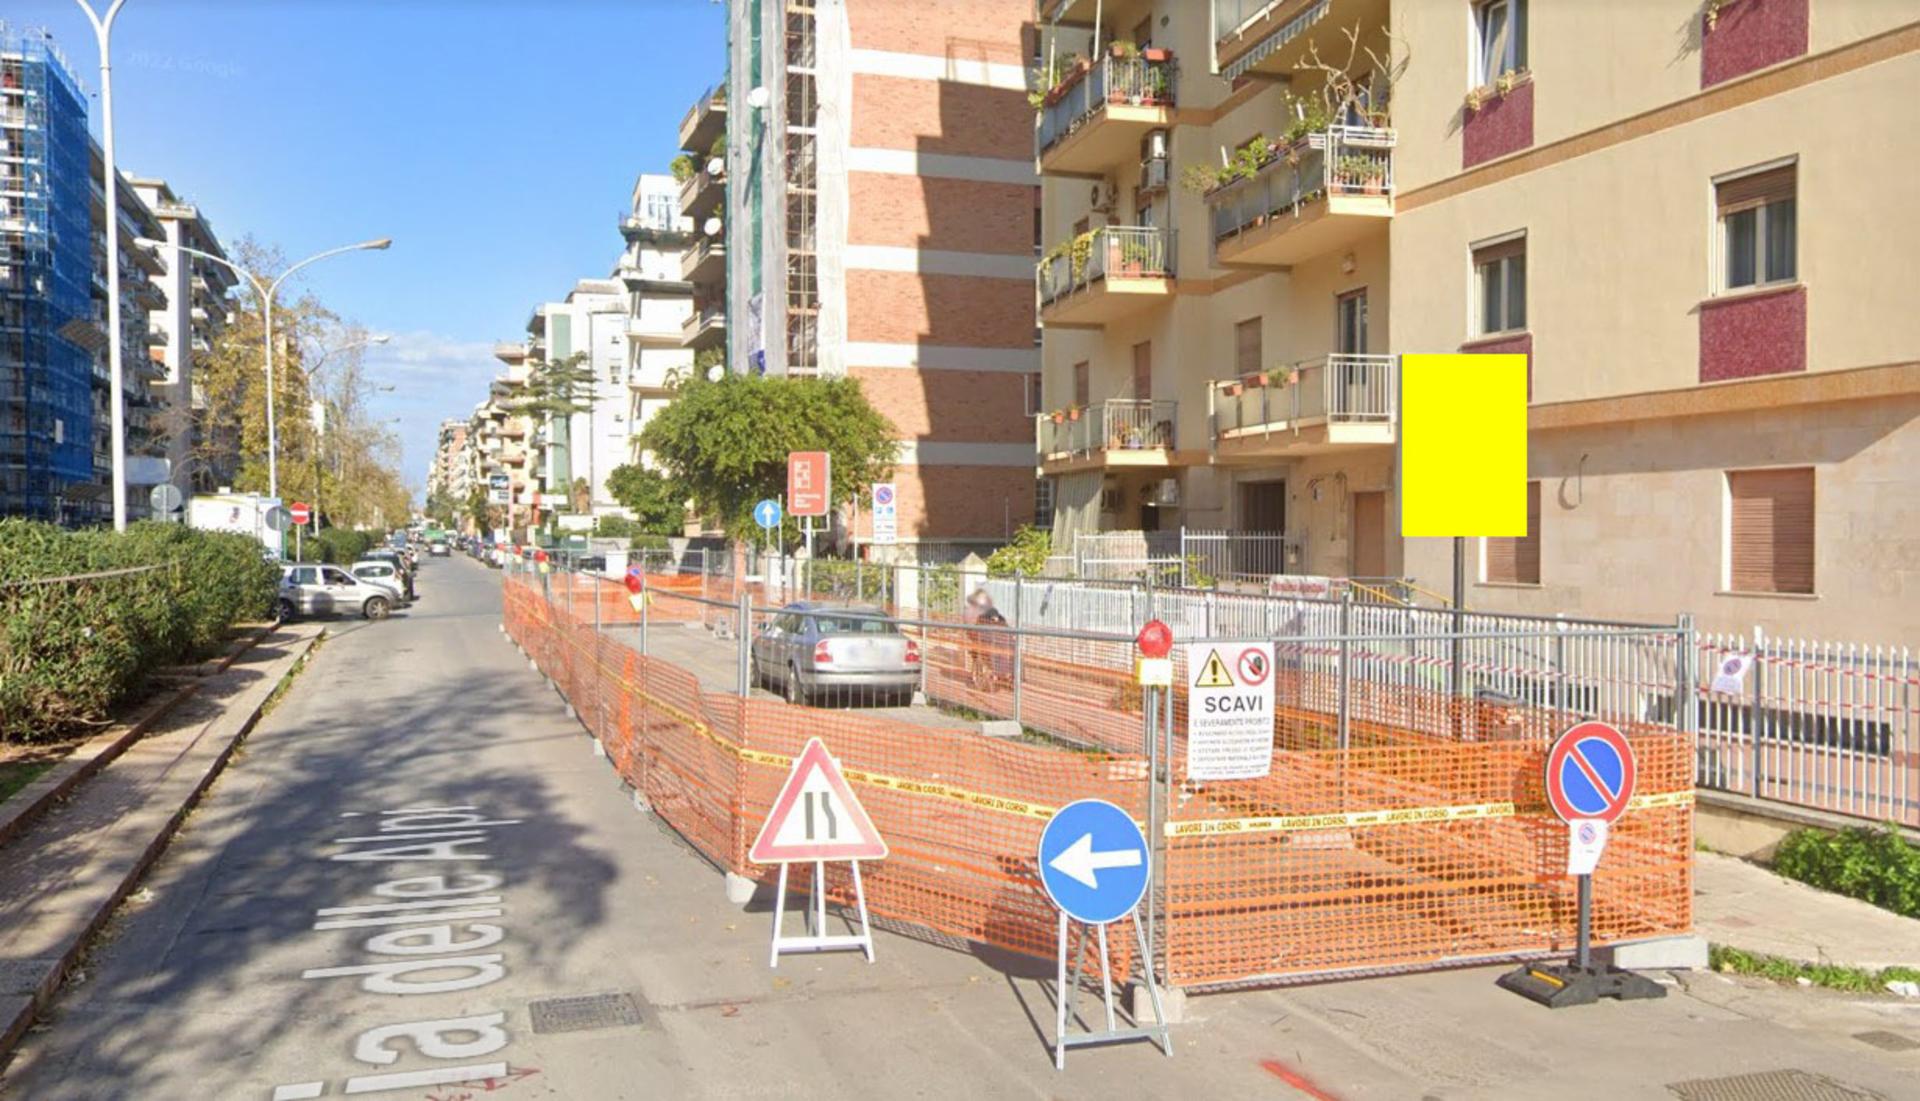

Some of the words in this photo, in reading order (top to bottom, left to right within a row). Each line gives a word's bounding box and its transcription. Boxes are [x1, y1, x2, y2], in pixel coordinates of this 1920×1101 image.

[1204, 695, 1263, 713] SCAVI
[1386, 811, 1412, 821] LAVORI
[1423, 808, 1449, 819] CORSO
[1486, 803, 1512, 814] LAVORI
[1175, 823, 1202, 834] LAVORI
[1204, 822, 1215, 832] IN
[1217, 821, 1242, 831] CORSO
[1281, 818, 1310, 828] LAVORI
[1311, 817, 1321, 826] IN
[1322, 816, 1348, 826] CORSO
